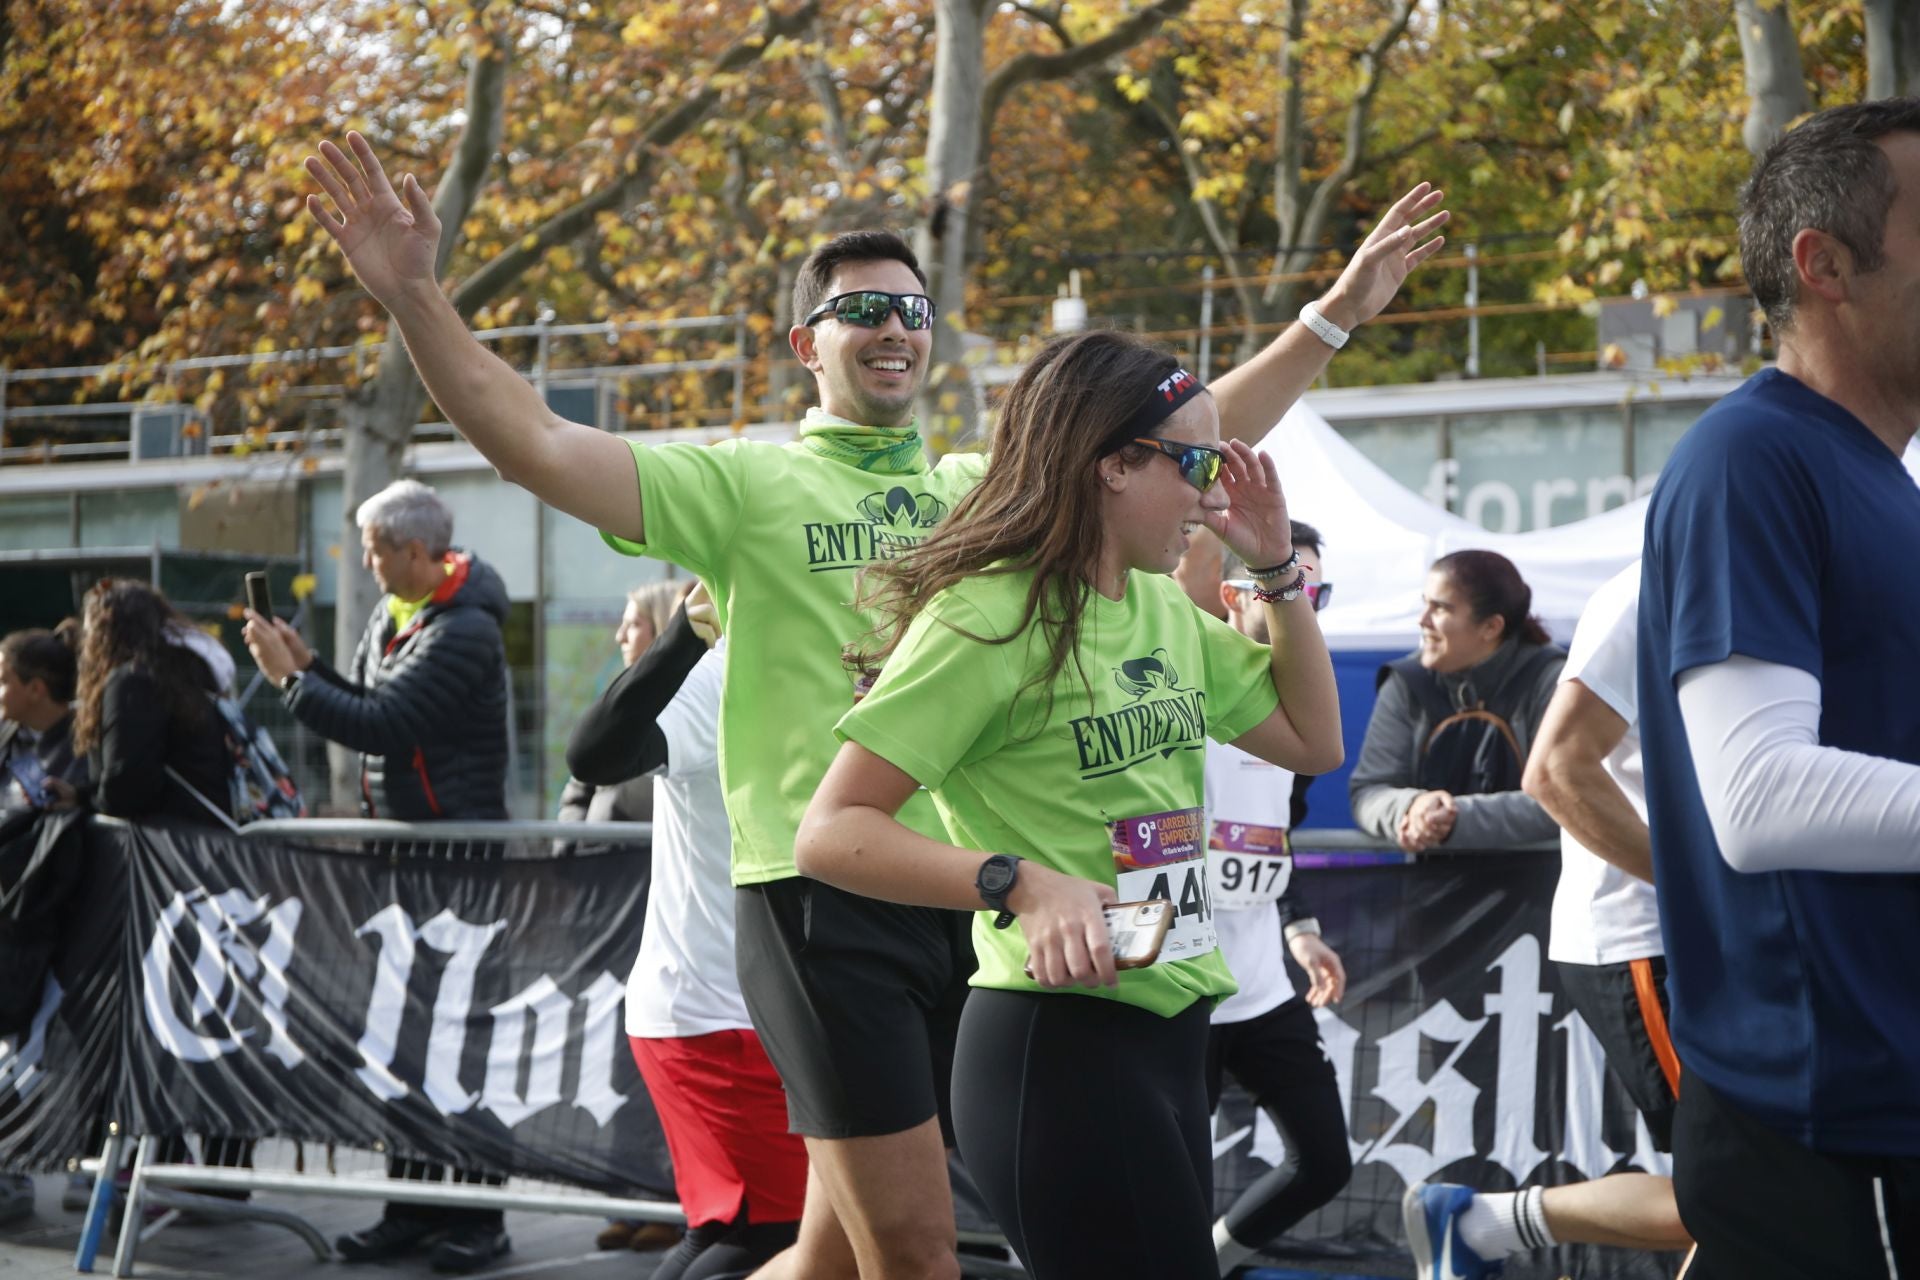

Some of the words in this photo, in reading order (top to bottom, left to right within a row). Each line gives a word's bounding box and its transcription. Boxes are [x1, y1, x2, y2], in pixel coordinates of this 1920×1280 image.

[1157, 814, 1191, 831] CARRERA
[1159, 826, 1200, 847] EMPRESAS
[1220, 856, 1283, 894] 917
[353, 902, 630, 1130] Nor
